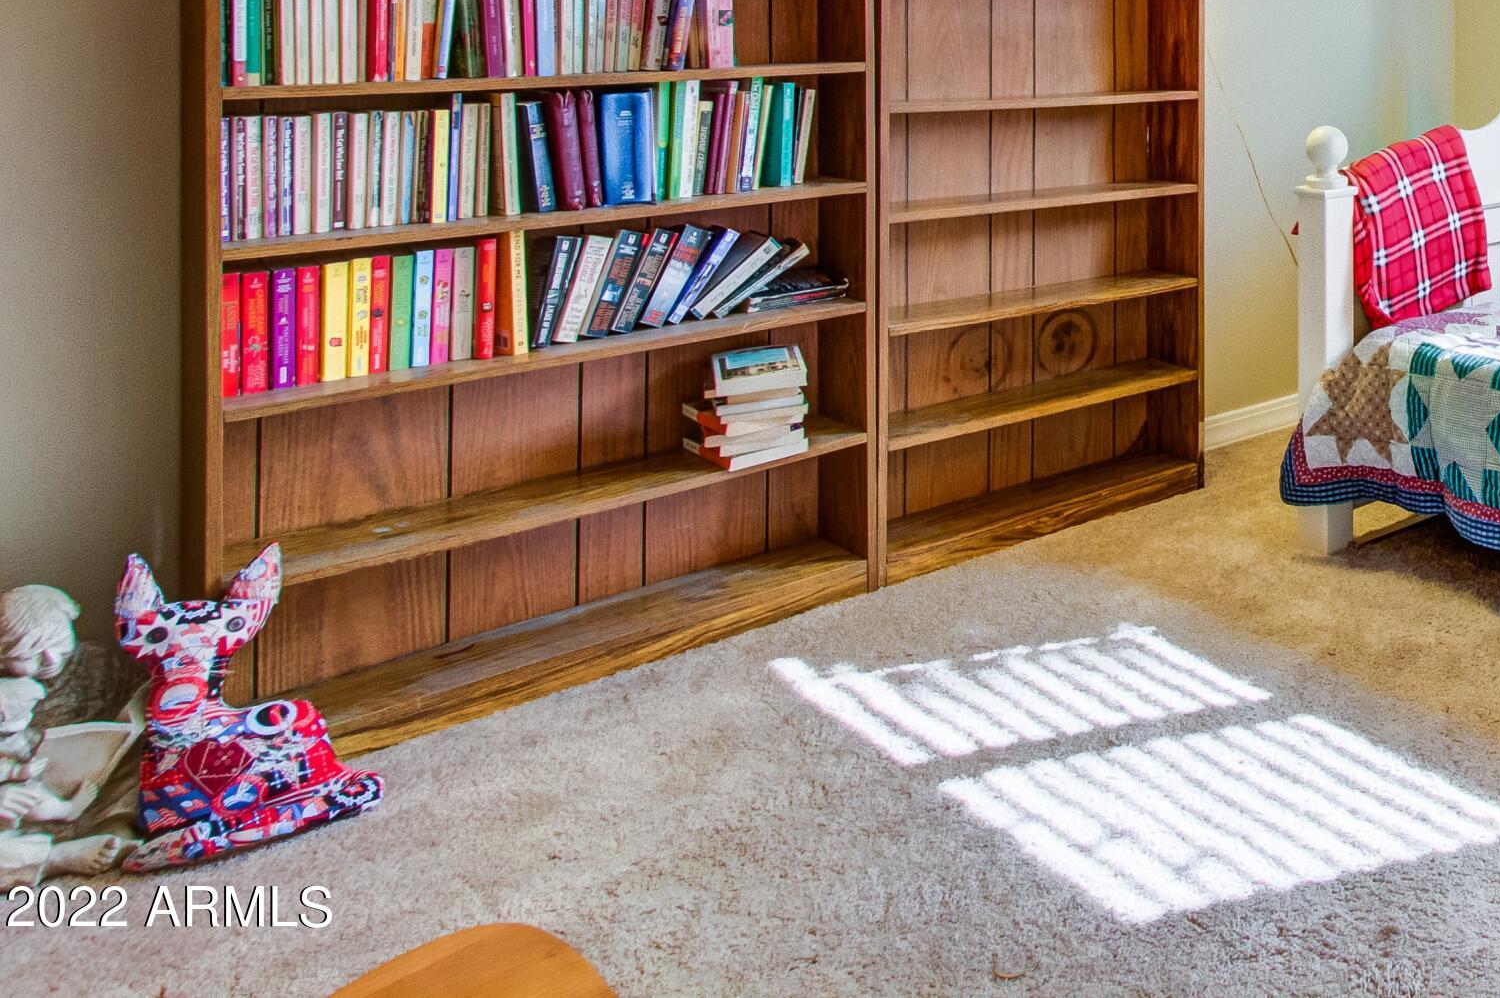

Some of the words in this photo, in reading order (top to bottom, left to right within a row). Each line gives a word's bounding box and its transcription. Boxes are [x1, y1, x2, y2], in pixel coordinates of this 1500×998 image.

[335, 129, 345, 138] The
[335, 138, 345, 147] Cat
[335, 147, 345, 159] Who
[335, 159, 345, 170] Saw
[335, 170, 345, 180] Red
[256, 289, 264, 316] CANDY
[256, 317, 264, 335] CANE
